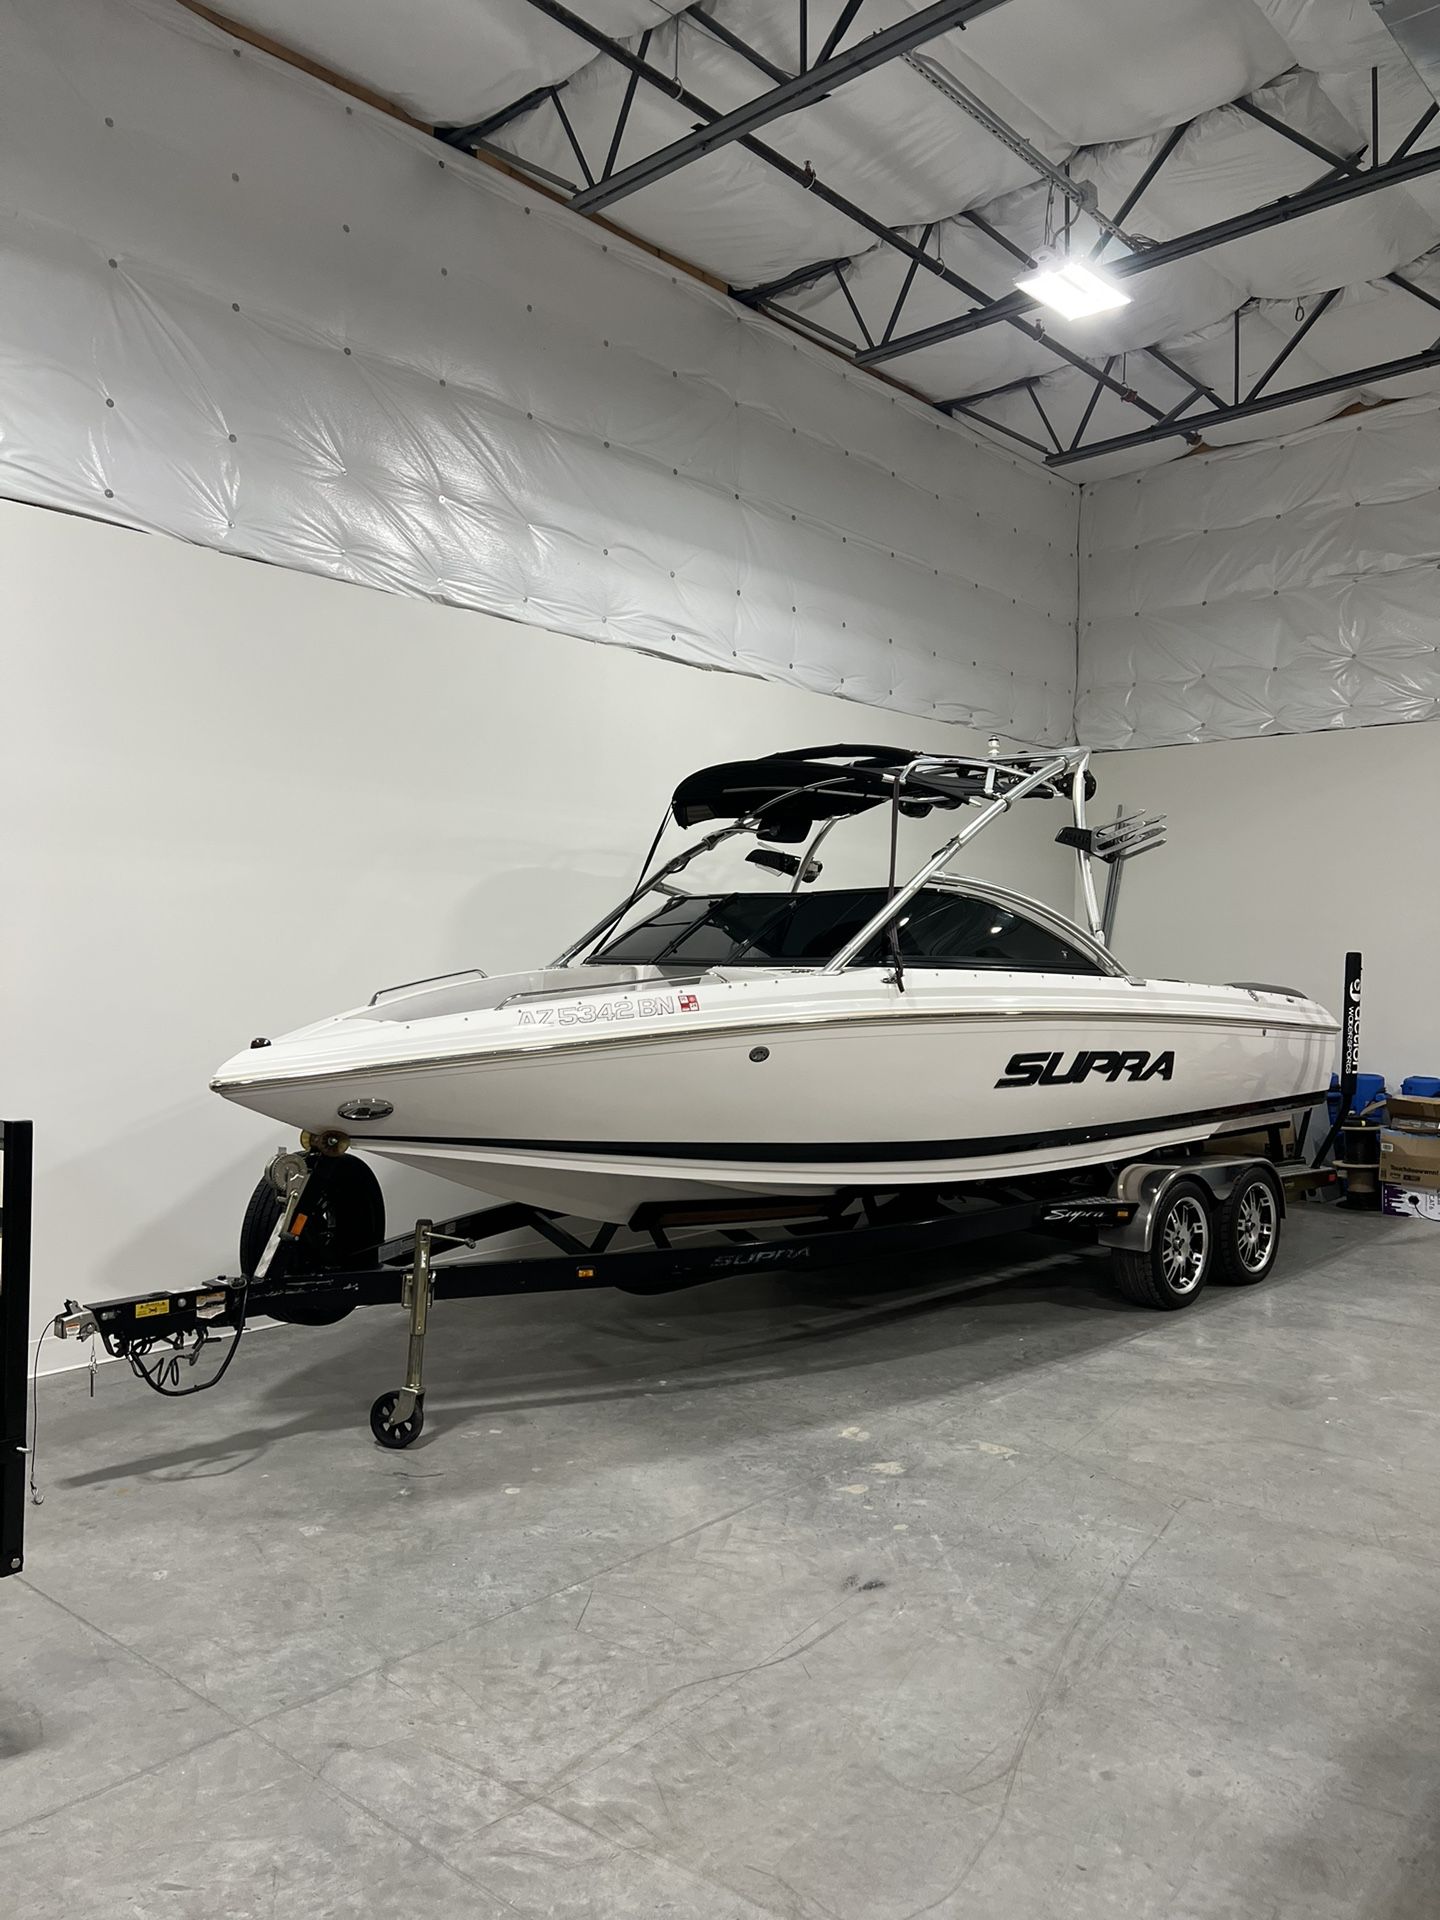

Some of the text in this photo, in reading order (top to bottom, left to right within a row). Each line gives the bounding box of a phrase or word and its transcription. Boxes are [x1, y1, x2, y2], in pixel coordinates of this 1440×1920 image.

[518, 995, 675, 1026] AZ 5342 BN
[993, 1050, 1175, 1089] SUPRA
[1043, 1208, 1105, 1223] Supra
[710, 1246, 810, 1267] SUPRA
